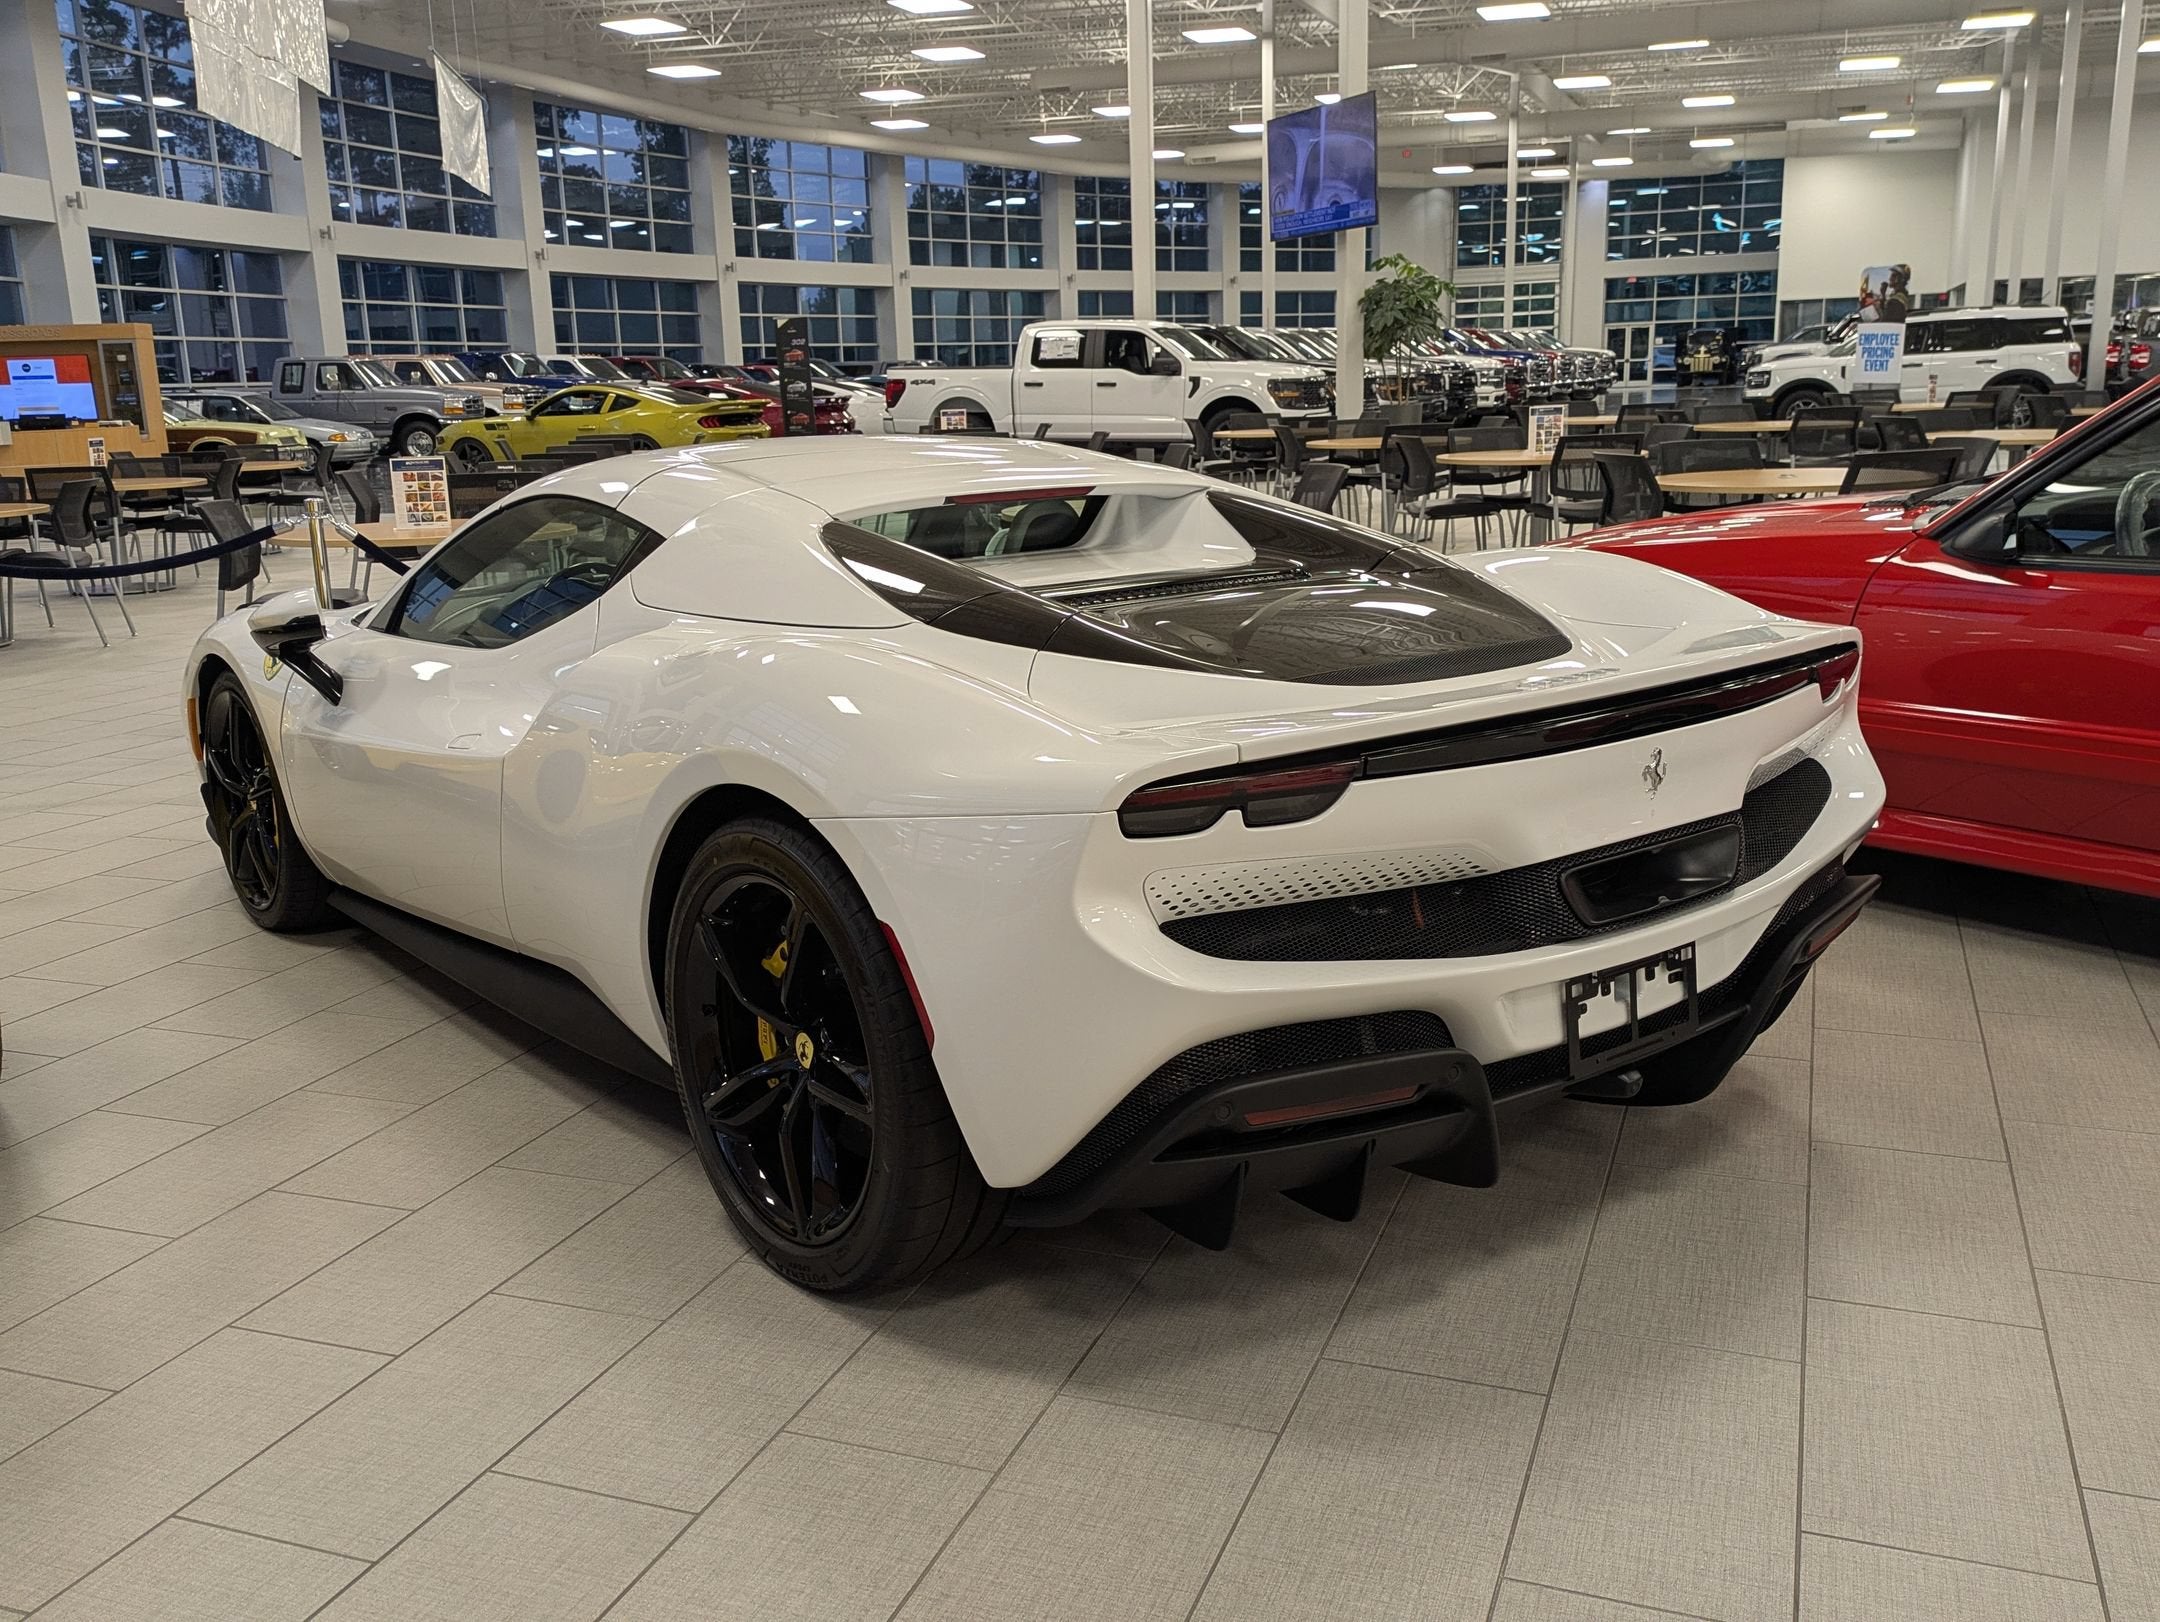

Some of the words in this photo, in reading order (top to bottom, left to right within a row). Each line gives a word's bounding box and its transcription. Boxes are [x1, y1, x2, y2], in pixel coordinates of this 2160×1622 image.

[1859, 333, 1899, 346] EMPLOYEE
[1861, 346, 1894, 359] PRICING
[1864, 359, 1889, 371] EVENT
